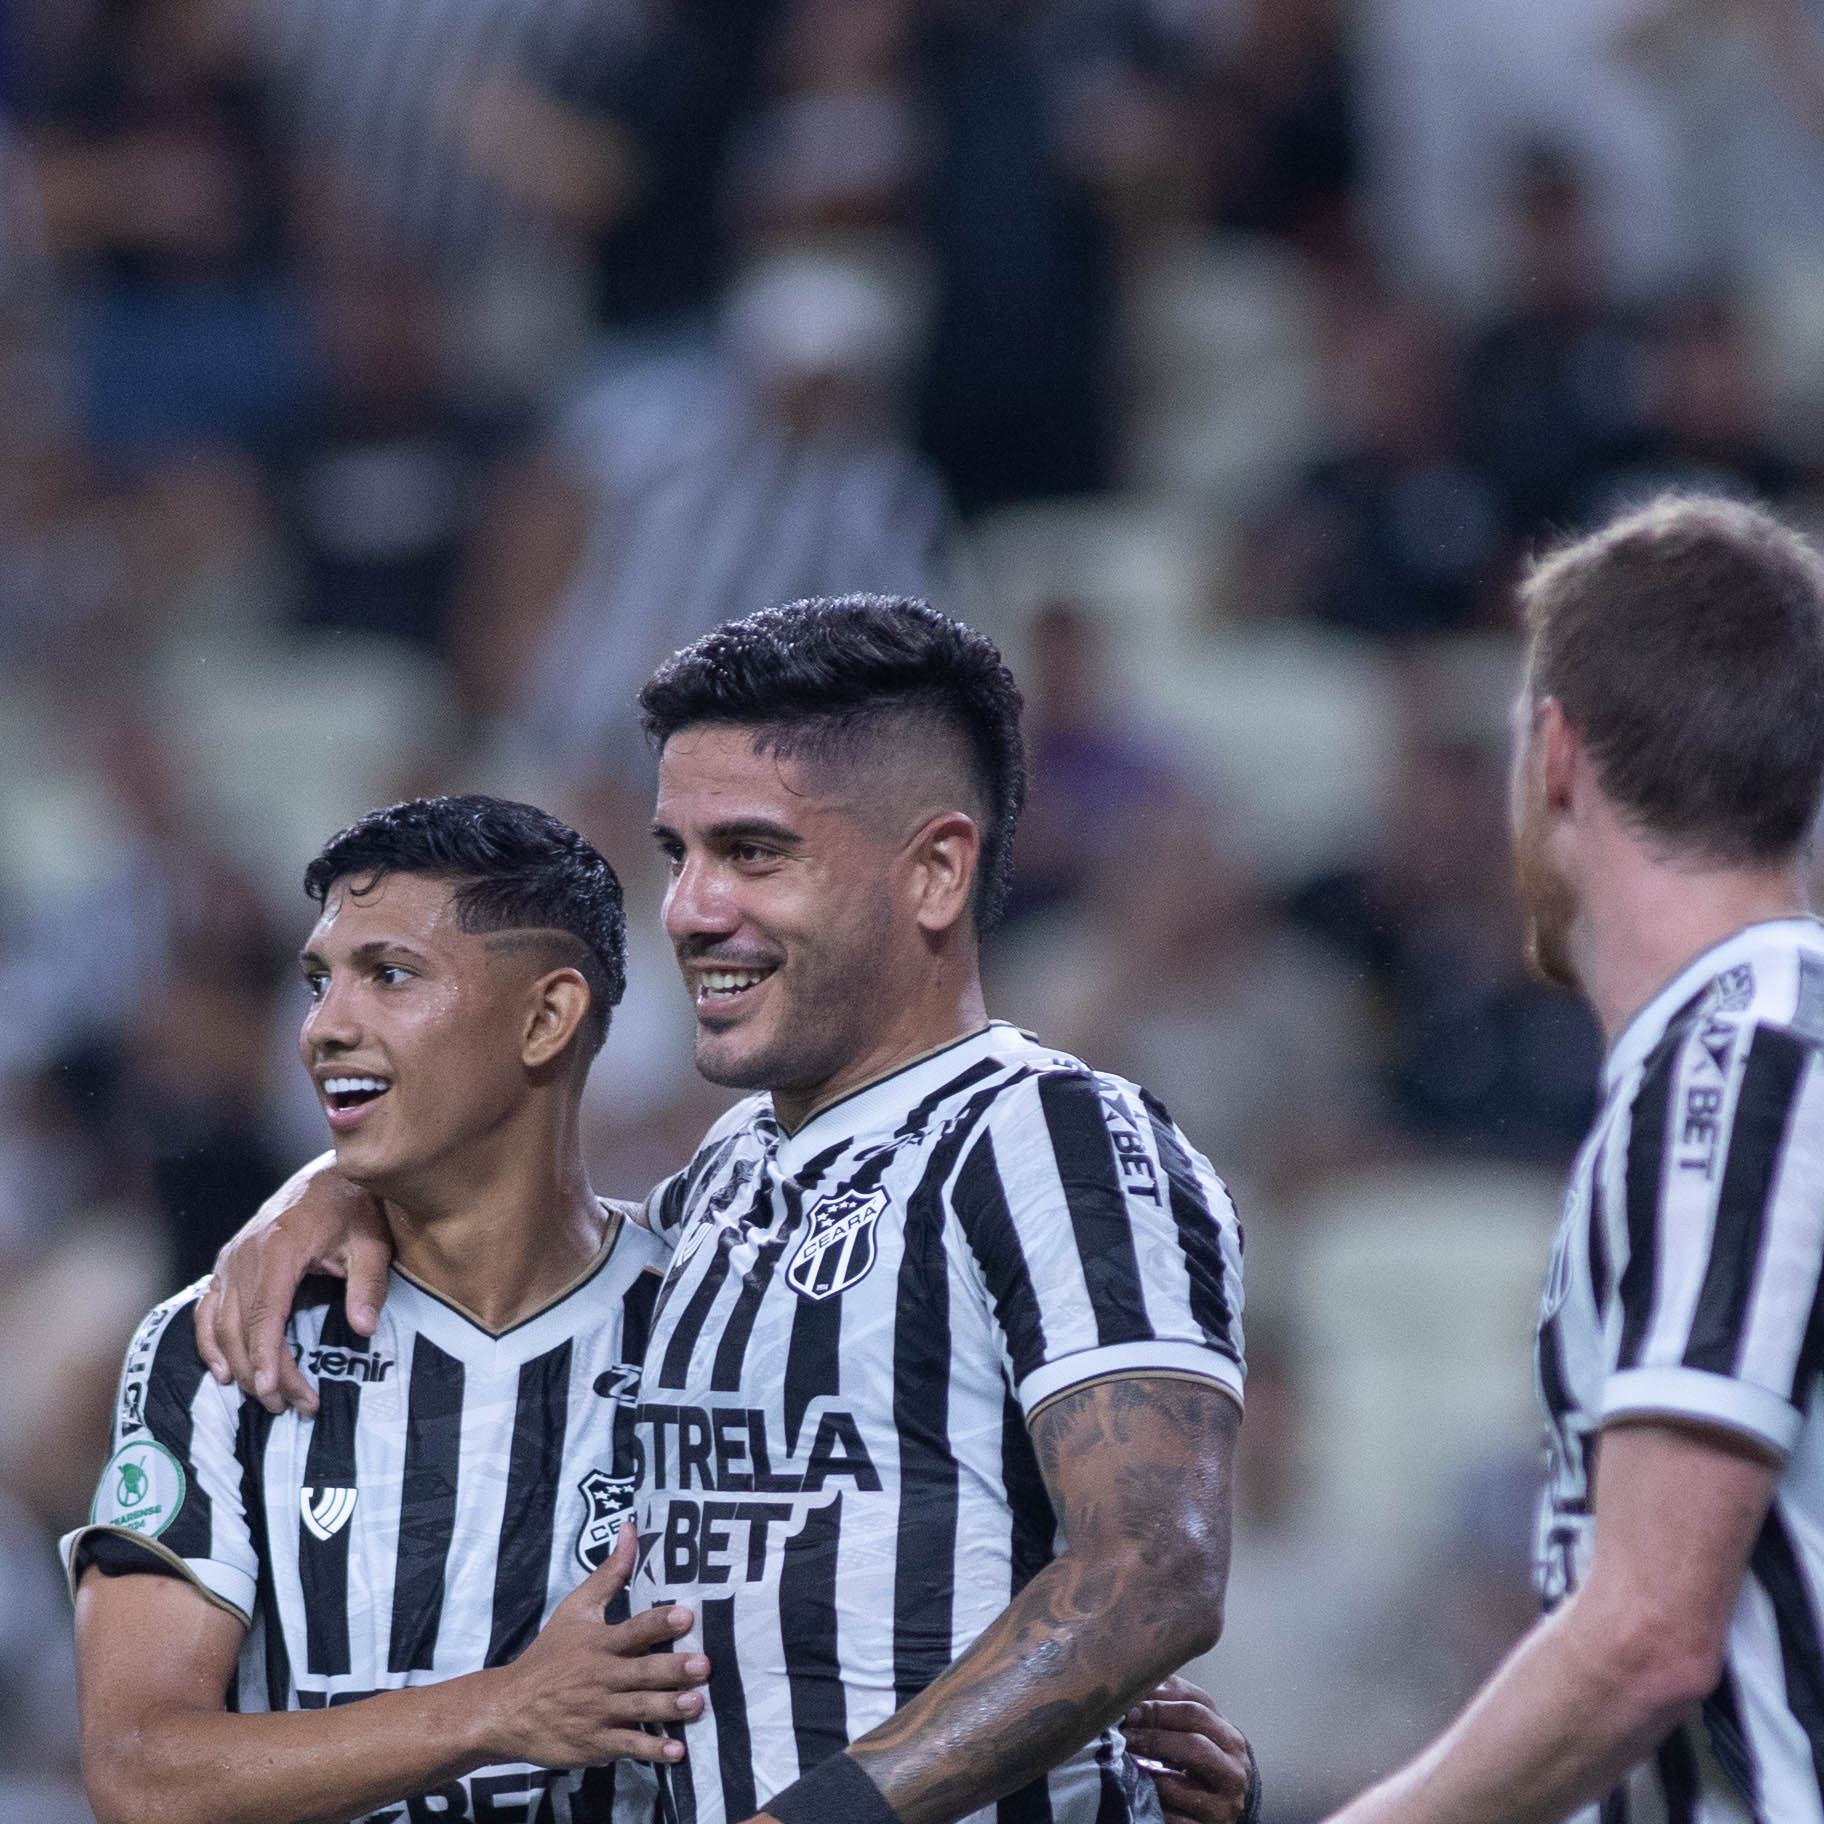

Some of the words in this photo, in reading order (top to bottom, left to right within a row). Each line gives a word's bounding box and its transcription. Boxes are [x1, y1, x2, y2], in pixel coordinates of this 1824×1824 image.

[1110, 1130, 1163, 1208] BET
[1679, 1084, 1722, 1182] BET
[664, 1499, 794, 1585] BET
